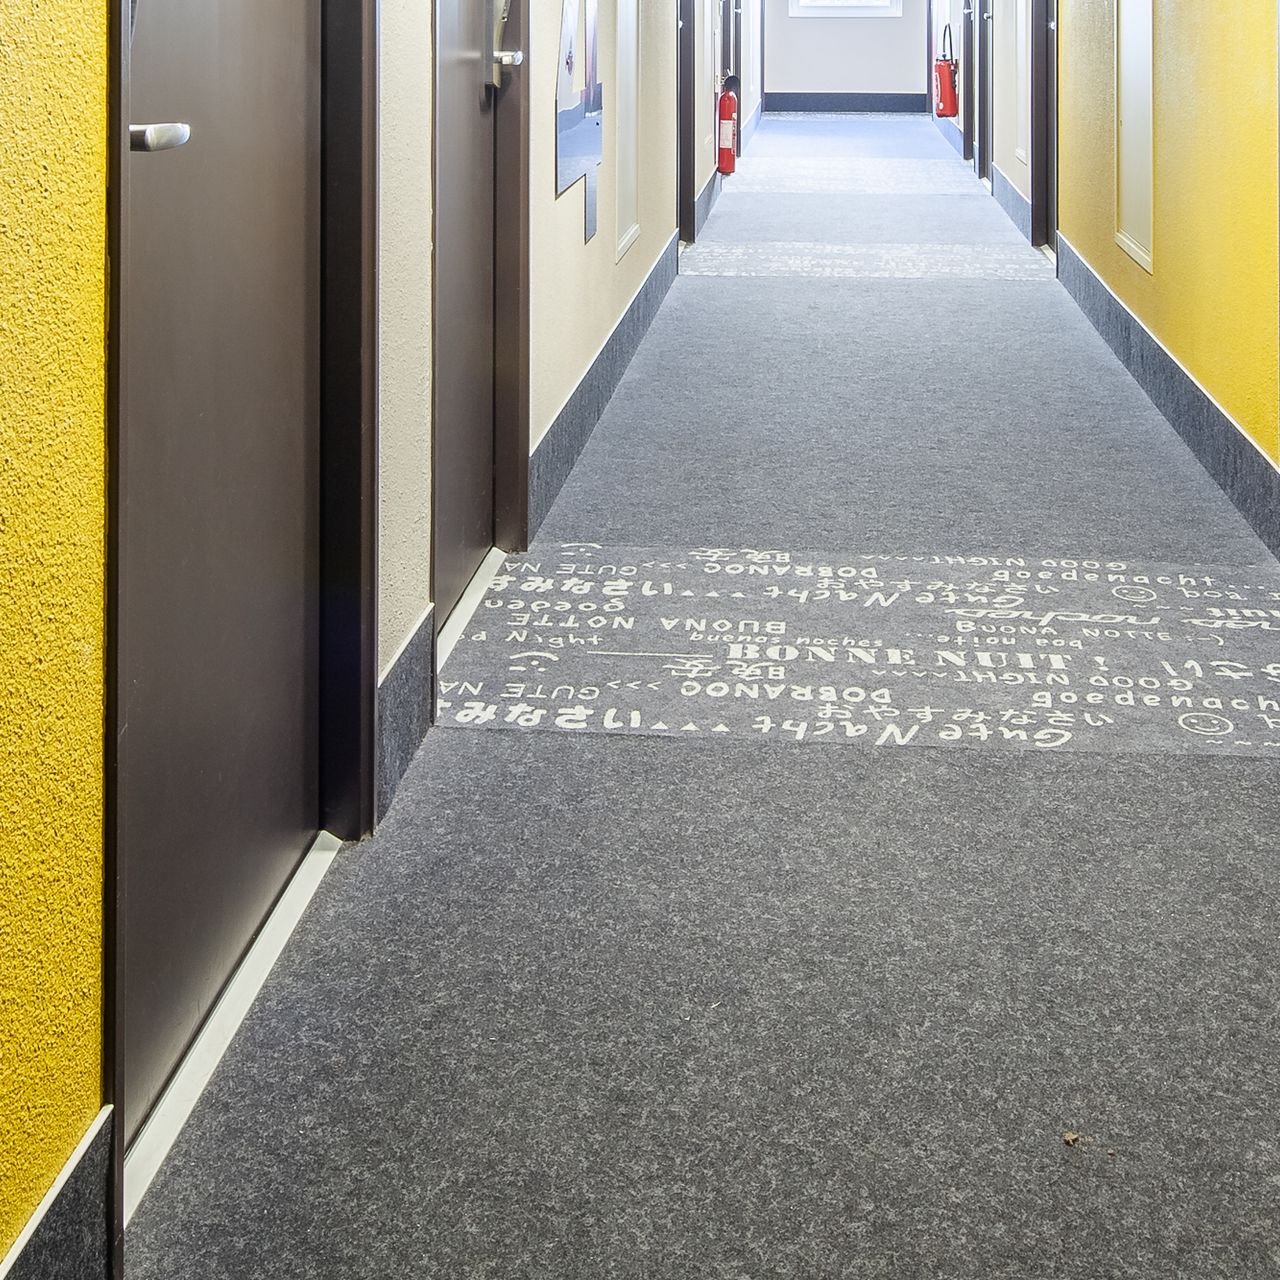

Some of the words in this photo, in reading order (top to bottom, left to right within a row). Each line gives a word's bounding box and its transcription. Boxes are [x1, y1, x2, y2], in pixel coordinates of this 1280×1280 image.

[555, 563, 638, 576] GUTE
[930, 555, 1026, 567] NIGHT
[1040, 559, 1127, 571] GOOD
[703, 562, 879, 578] DOBRANOC
[763, 585, 901, 607] Nacht
[914, 591, 1025, 608] Gute
[1176, 586, 1248, 601] boa
[506, 612, 636, 630] NOTTE
[943, 607, 1161, 626] noches
[659, 617, 787, 634] BUONA
[1081, 627, 1173, 641] NOTTE
[504, 630, 604, 648] Night
[689, 631, 781, 644] buenas
[796, 636, 884, 648] noches
[1036, 639, 1083, 650] boa
[727, 643, 916, 665] BONNE
[934, 650, 1073, 670] NUIT
[953, 670, 1070, 686] NIGHT
[1088, 675, 1193, 691] GOOD
[499, 682, 601, 700] GUTE
[679, 680, 892, 703] DOBRANOC
[816, 702, 1115, 727] おやすみなさい
[751, 715, 921, 746] Nacht
[937, 723, 1073, 748] Gute
